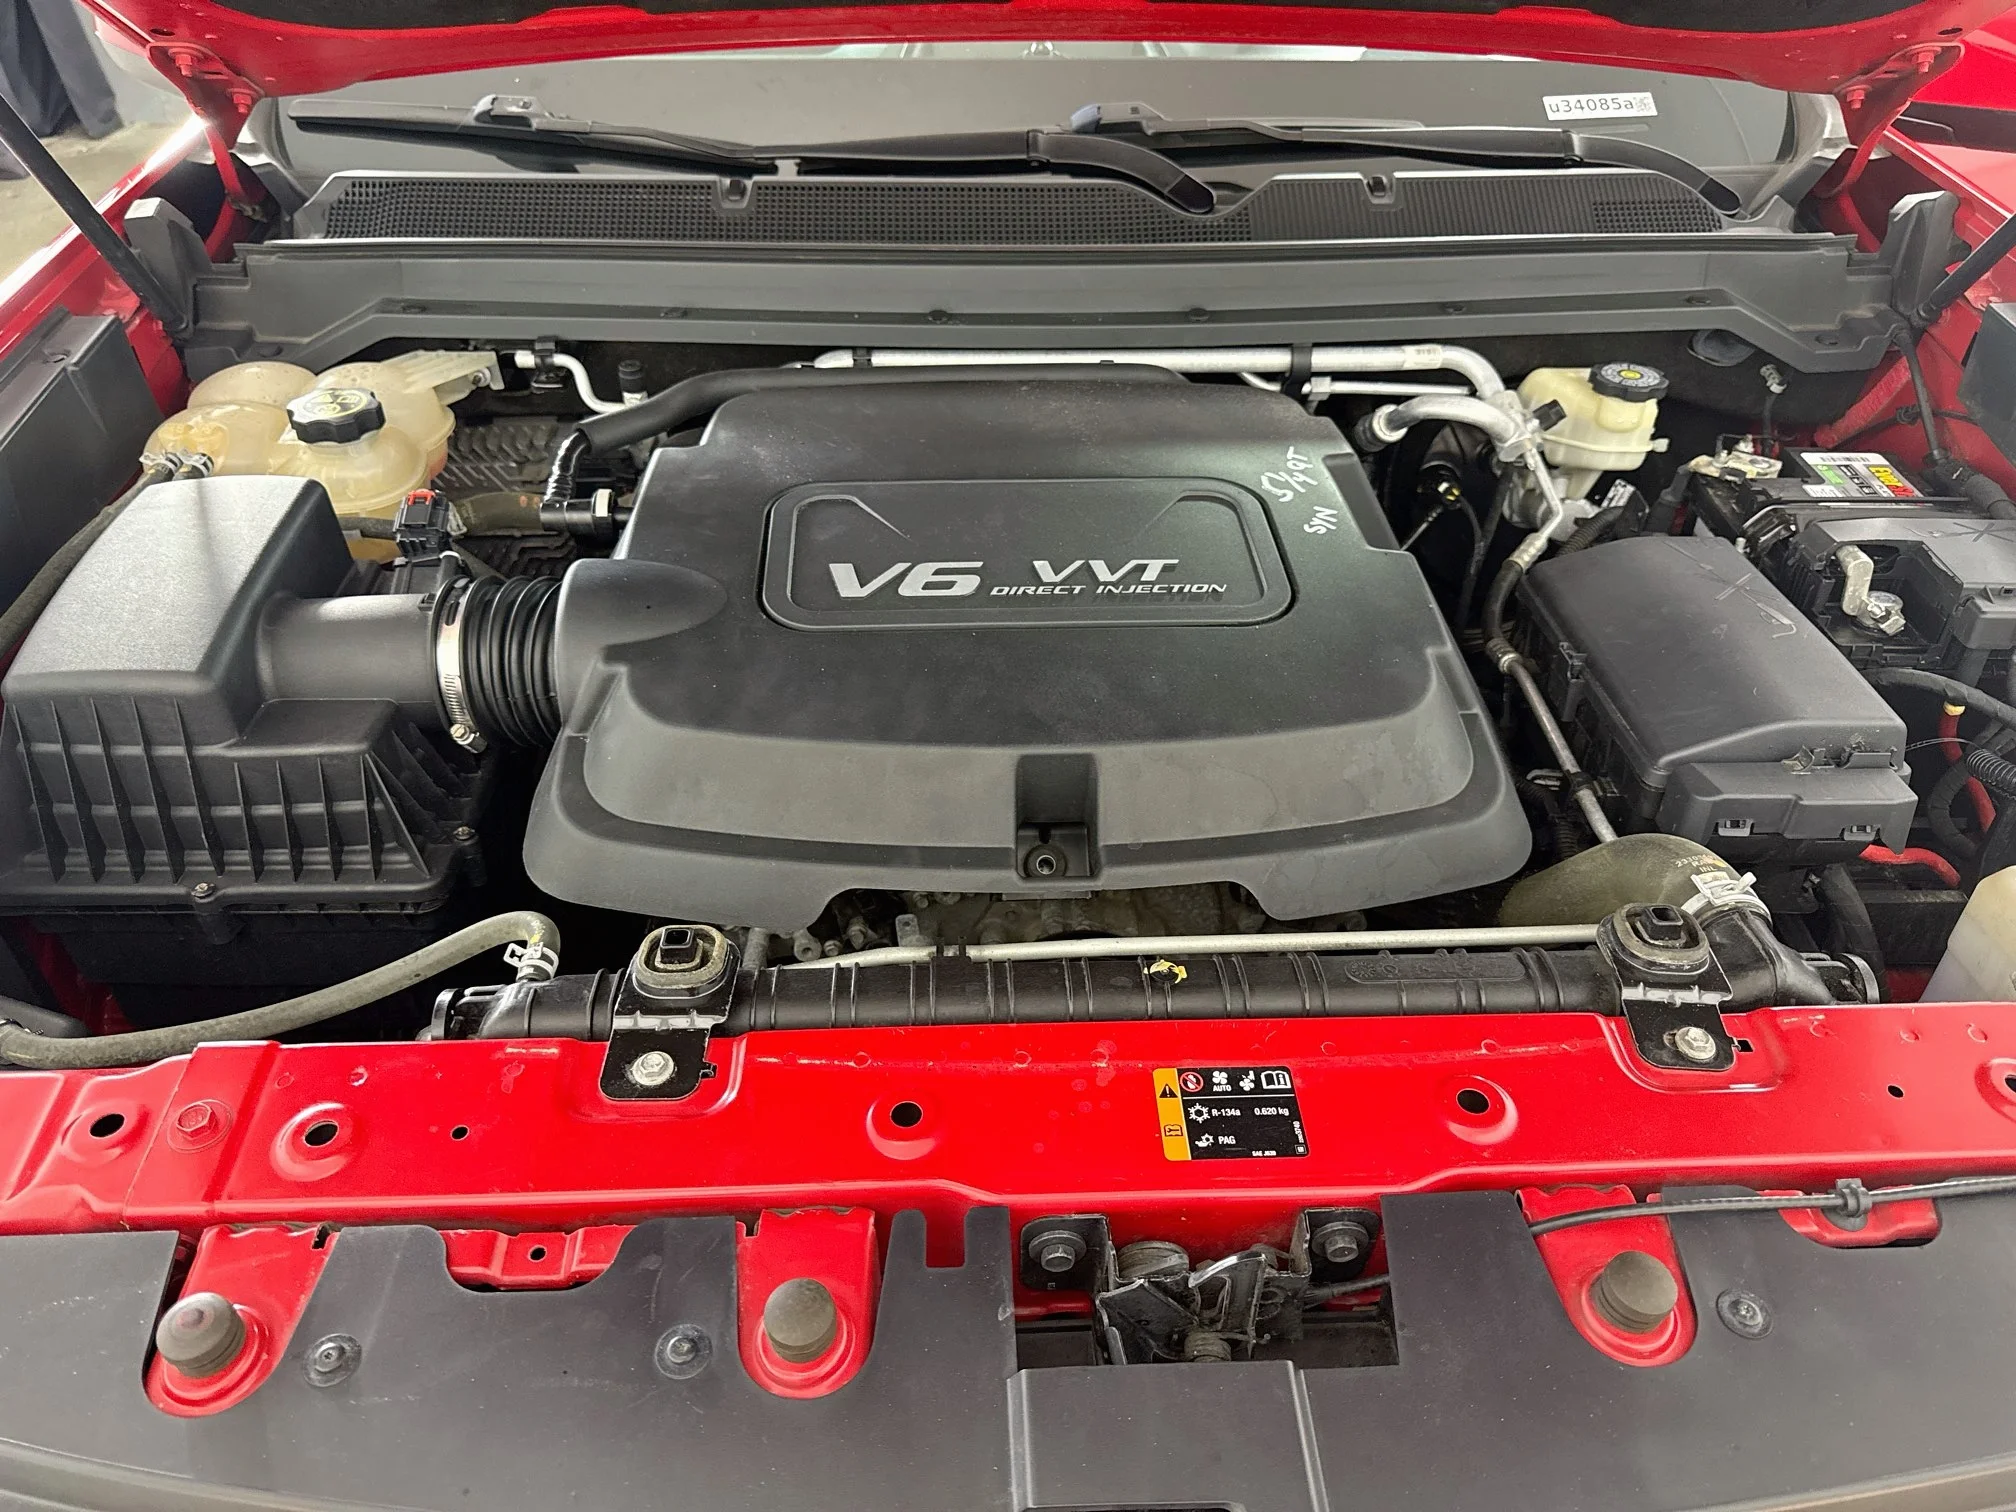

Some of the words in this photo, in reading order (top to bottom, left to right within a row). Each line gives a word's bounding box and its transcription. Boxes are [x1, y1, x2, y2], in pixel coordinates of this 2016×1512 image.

[1549, 97, 1634, 113] u34085a
[1303, 505, 1338, 534] SYN
[829, 561, 984, 598] V6
[1032, 559, 1181, 583] VVT
[990, 584, 1085, 596] DIRECT
[1095, 584, 1228, 596] INJECTION
[1212, 1084, 1232, 1092] AUTO
[1211, 1108, 1241, 1117] R-134a
[1254, 1107, 1277, 1116] 0.620
[1278, 1106, 1290, 1117] kg
[1218, 1135, 1236, 1145] PAG
